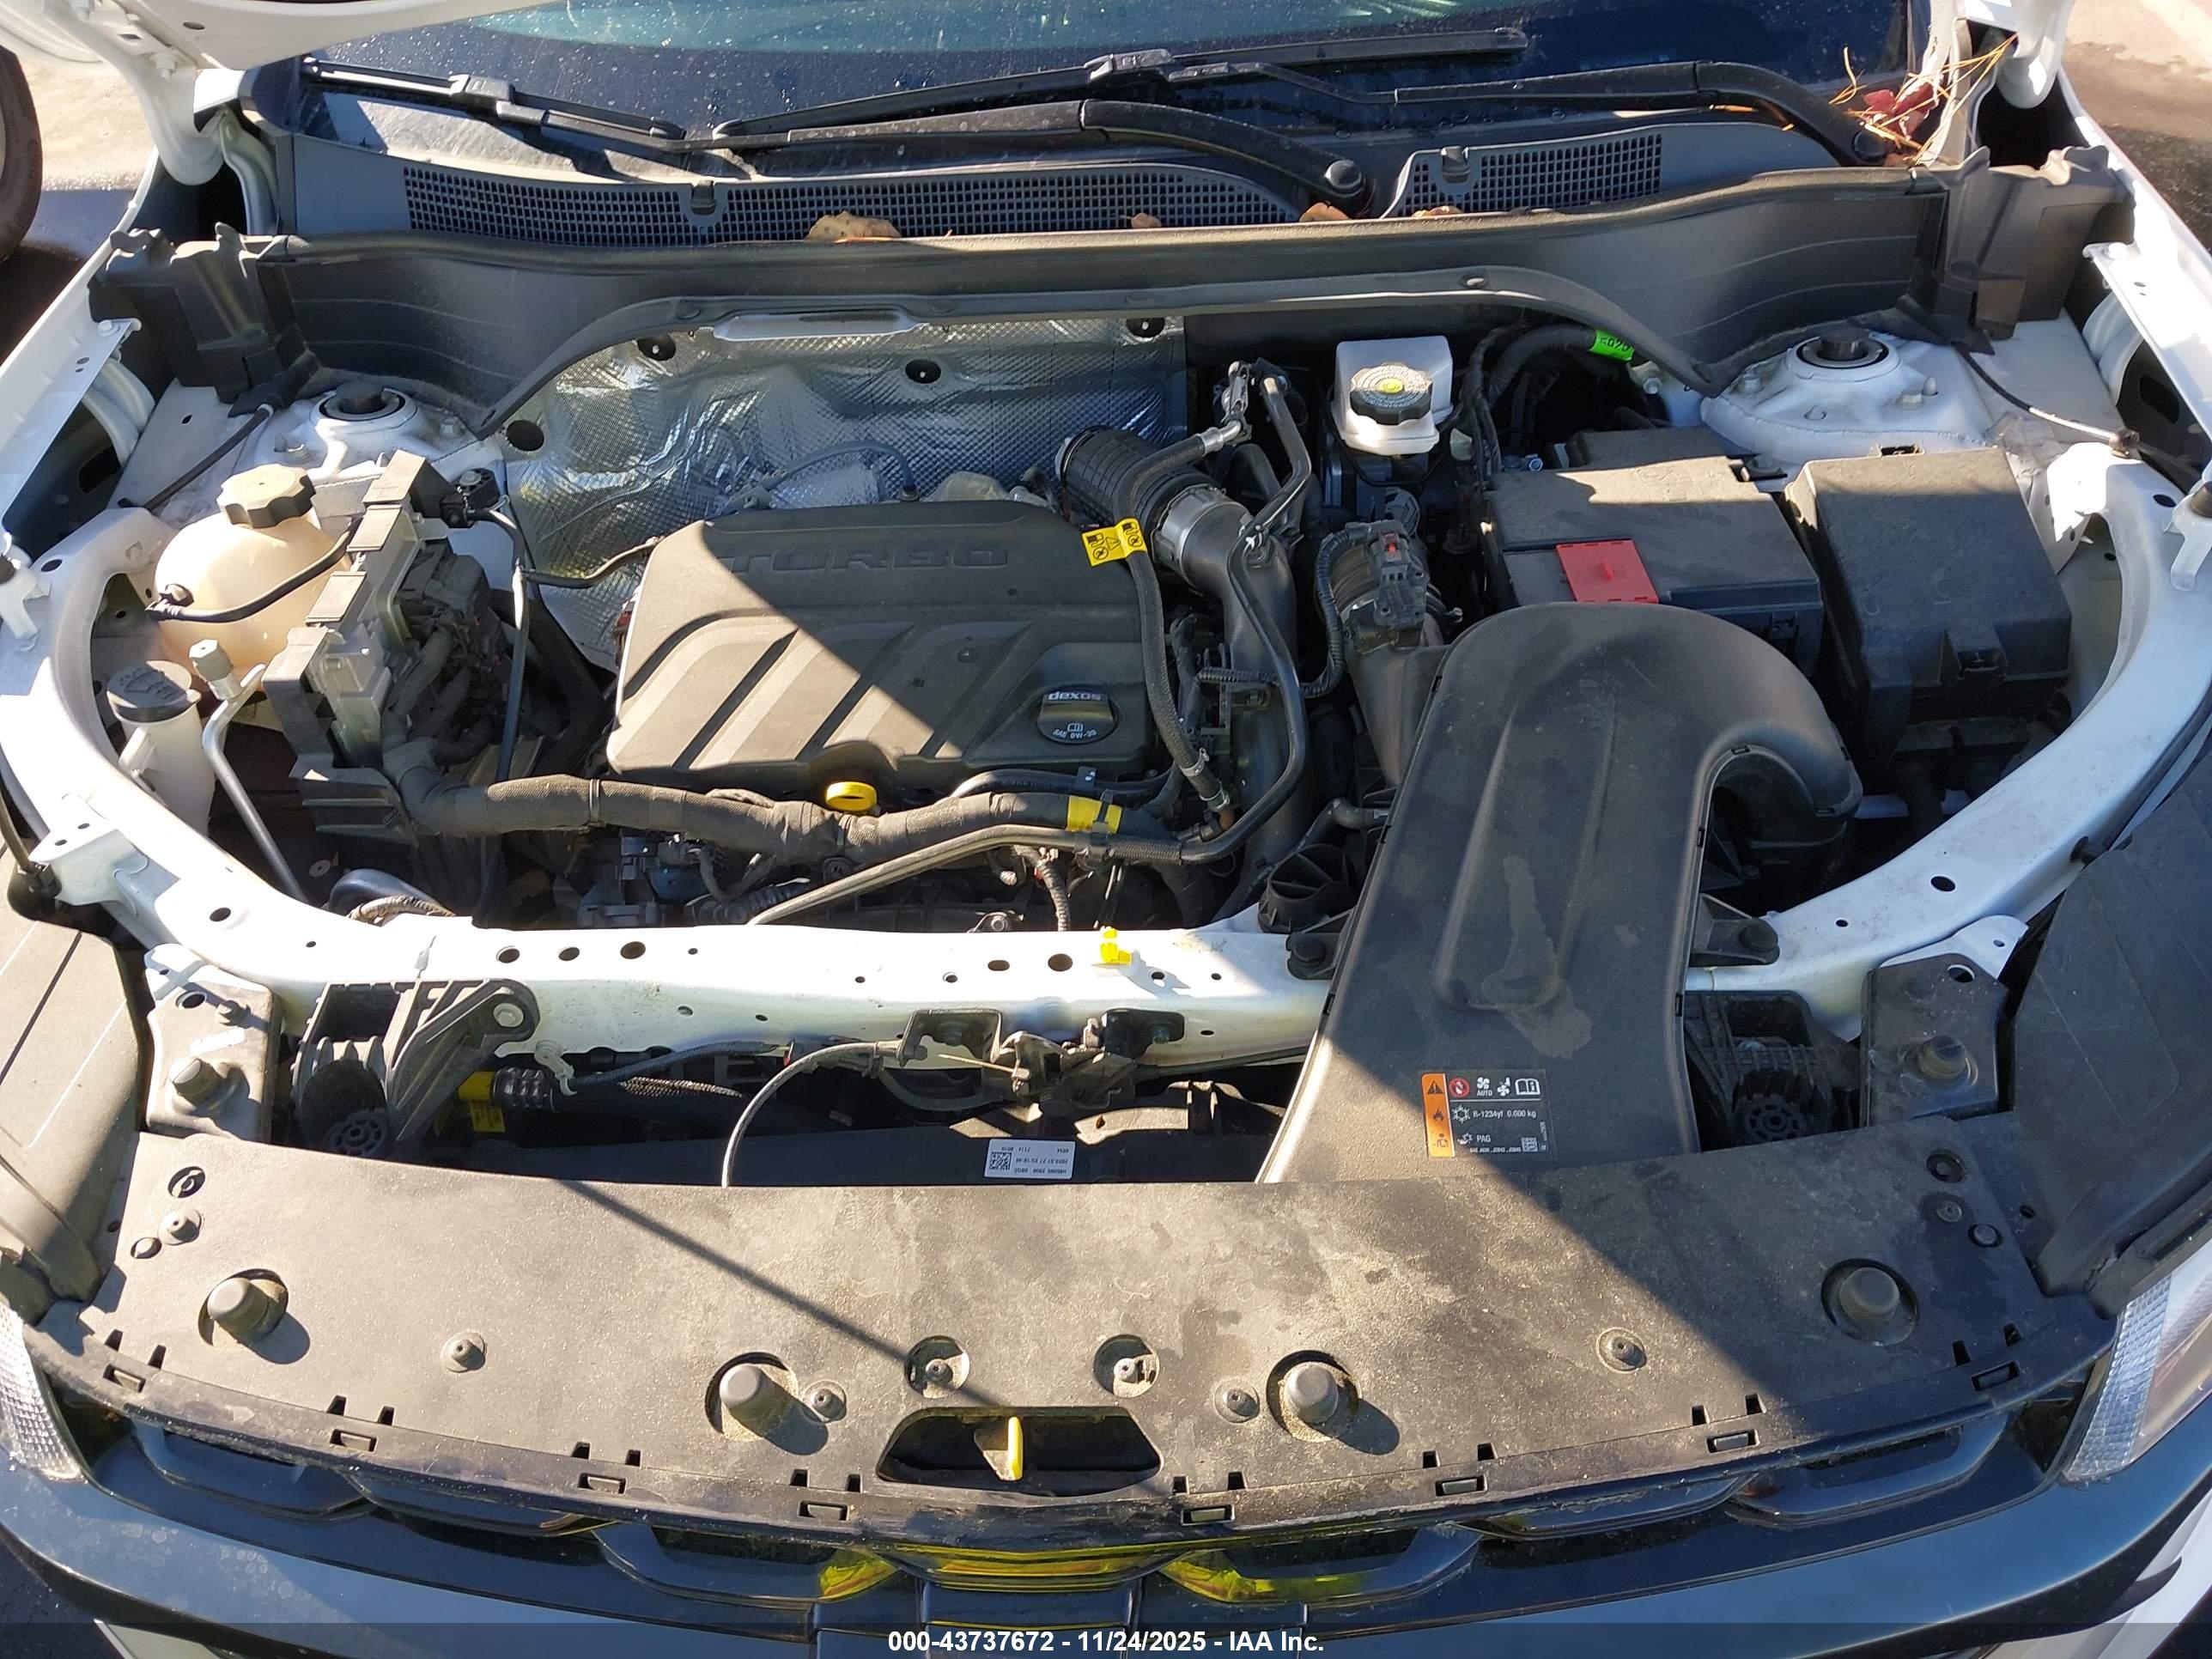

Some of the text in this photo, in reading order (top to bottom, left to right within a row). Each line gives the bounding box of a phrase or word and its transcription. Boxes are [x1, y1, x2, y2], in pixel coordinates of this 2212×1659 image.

[717, 548, 1009, 574] TURBO
[1048, 691, 1102, 701] dexos
[1527, 1109, 1536, 1118] kg
